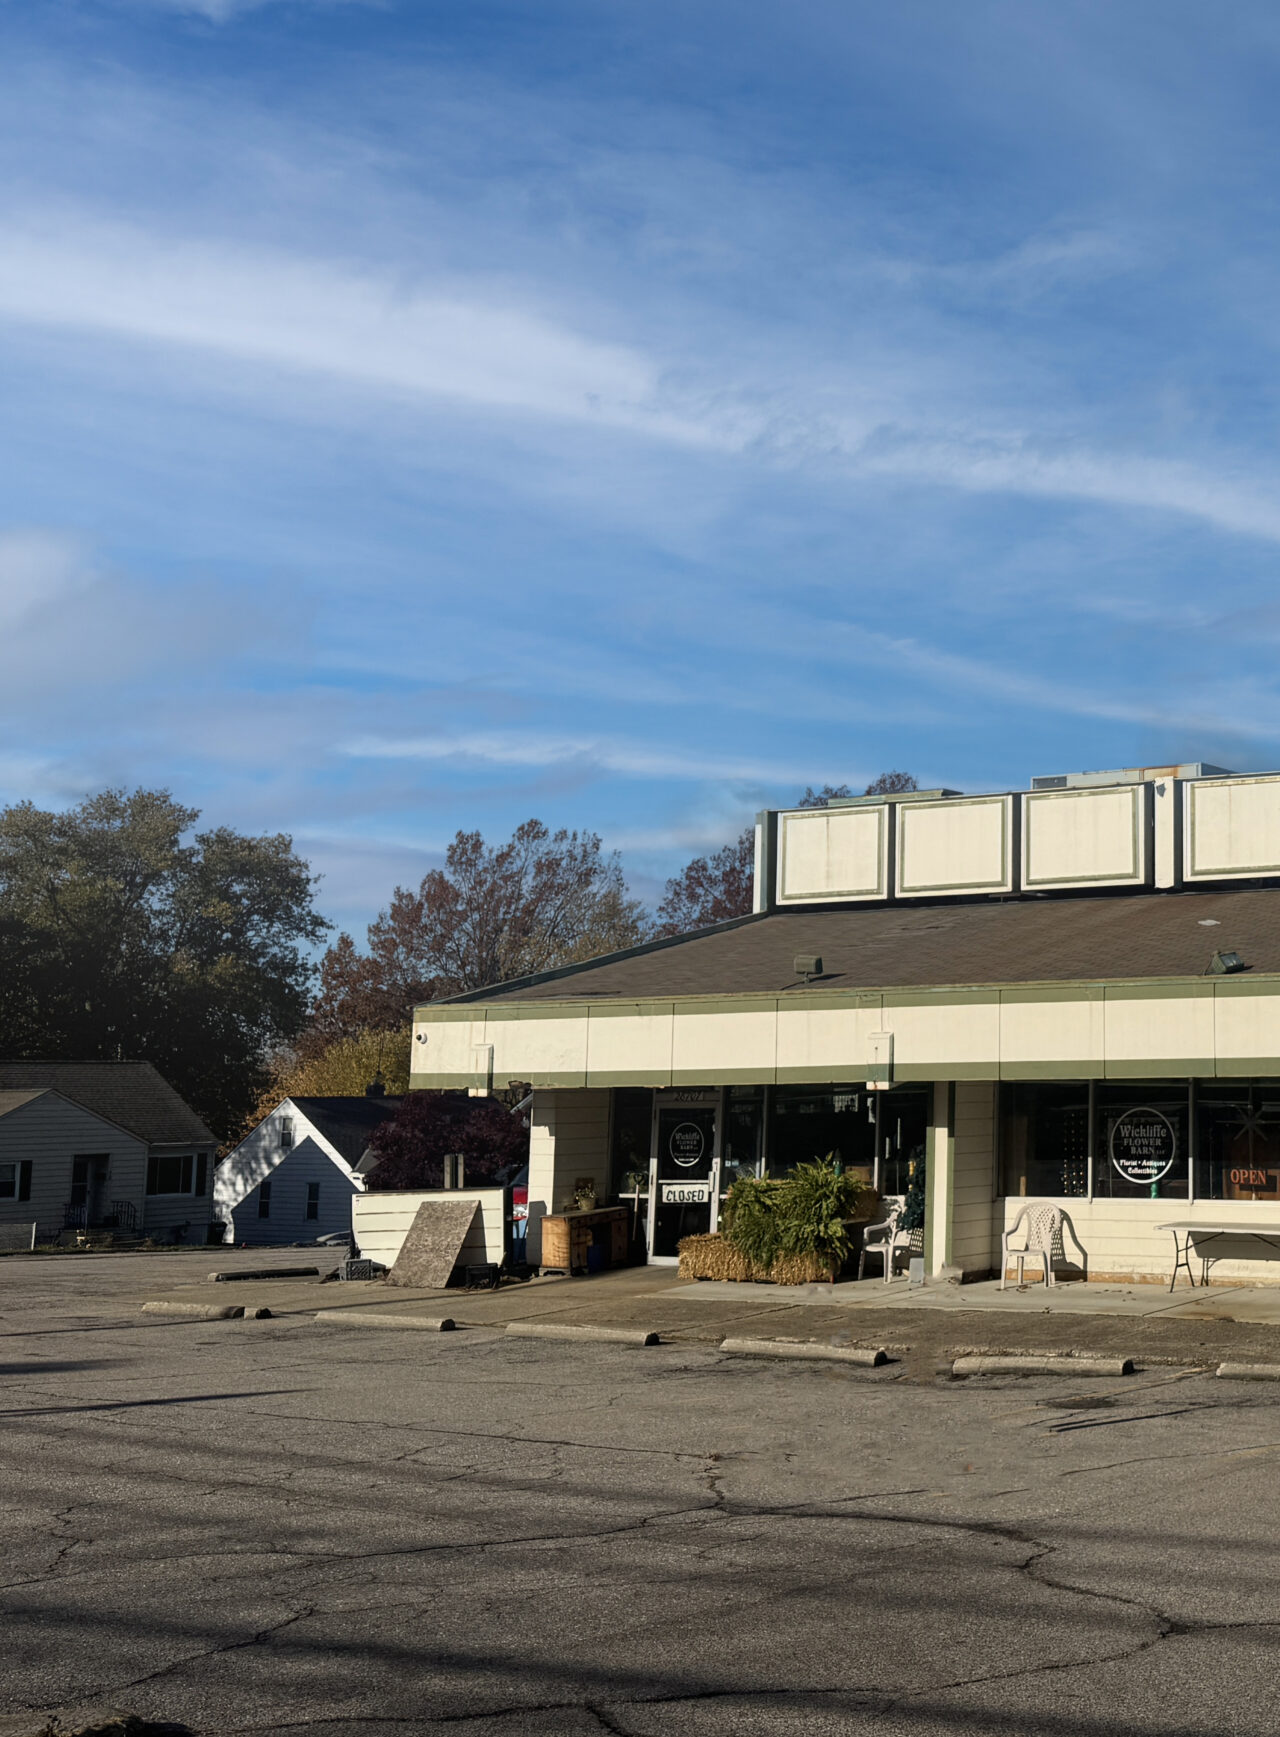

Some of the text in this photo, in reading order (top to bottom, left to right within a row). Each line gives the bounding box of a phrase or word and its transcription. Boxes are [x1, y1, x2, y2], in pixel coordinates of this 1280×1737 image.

[1119, 1124, 1167, 1137] Wickliffe
[1123, 1138, 1162, 1146] FLOWER
[1130, 1146, 1155, 1155] BARN
[1141, 1159, 1166, 1168] Antiques
[1230, 1169, 1266, 1185] OPEN
[666, 1189, 705, 1202] CLOSED
